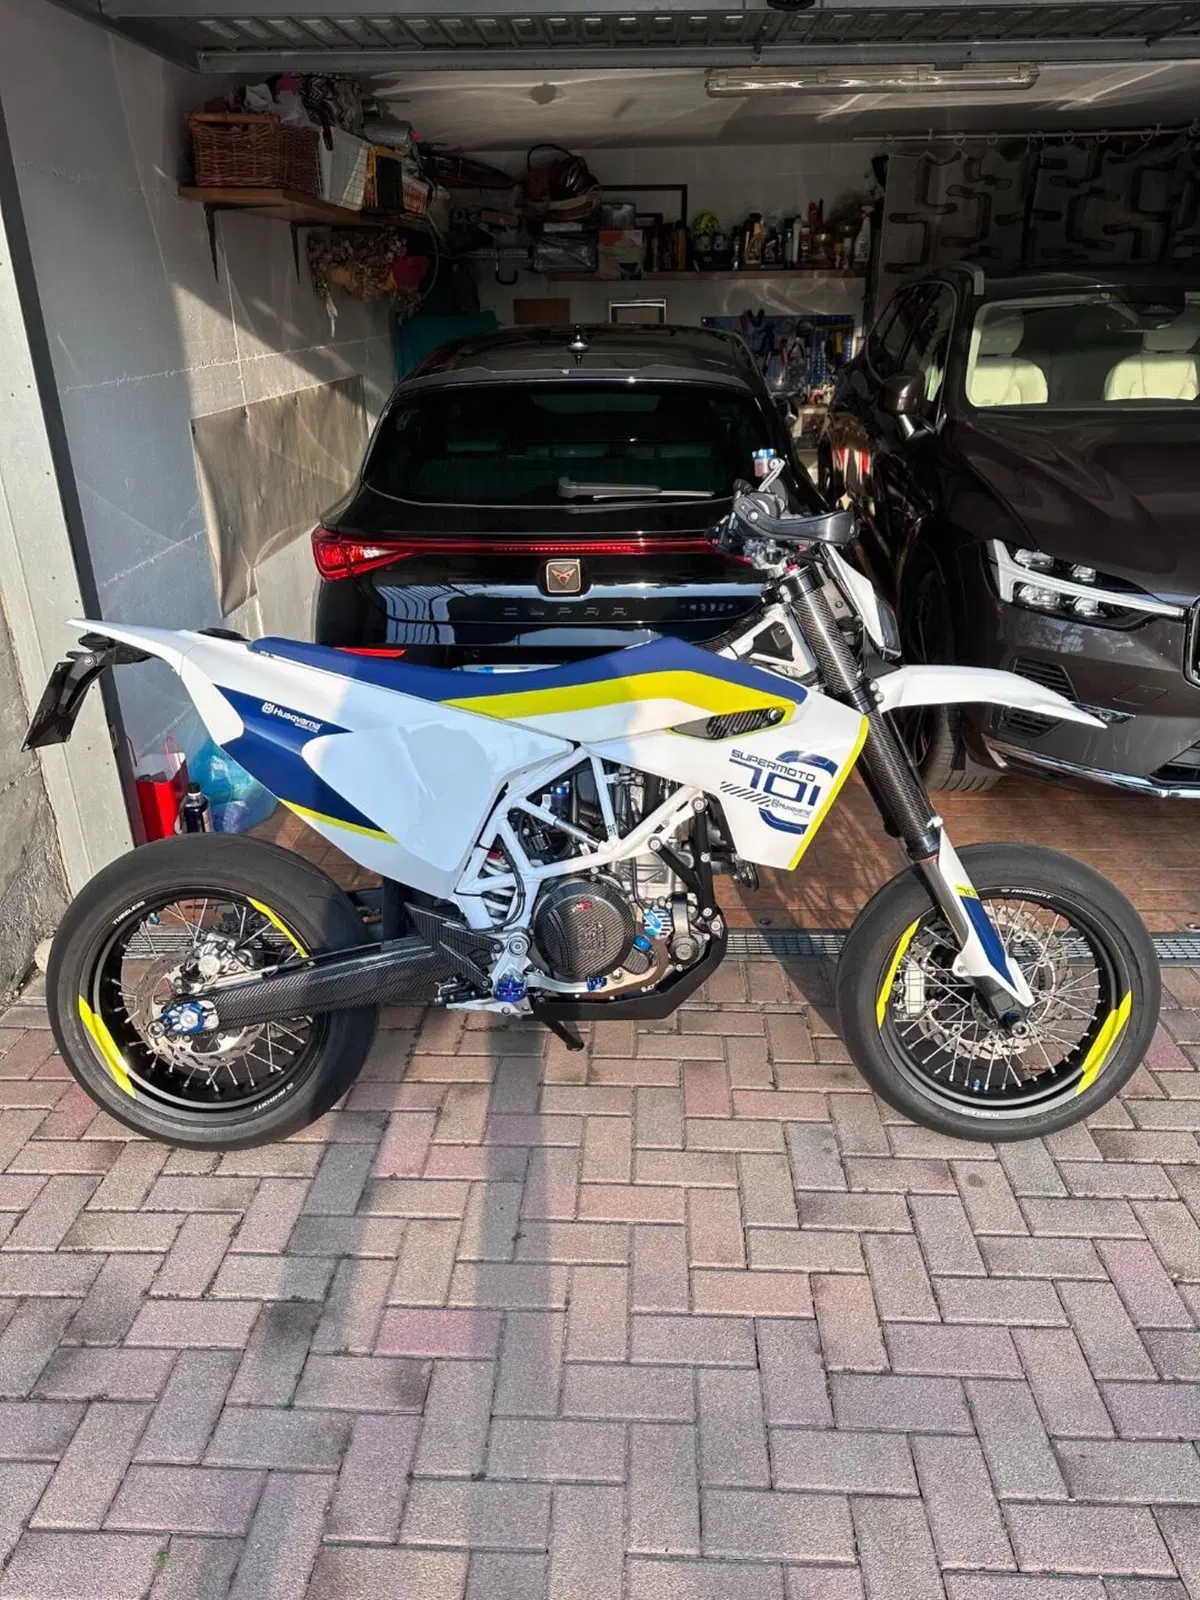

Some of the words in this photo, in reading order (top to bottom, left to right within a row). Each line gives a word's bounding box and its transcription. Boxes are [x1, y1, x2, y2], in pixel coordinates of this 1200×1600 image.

[273, 707, 321, 730] Husqvarna
[729, 758, 822, 807] 701
[731, 749, 816, 783] SUPERMOTO
